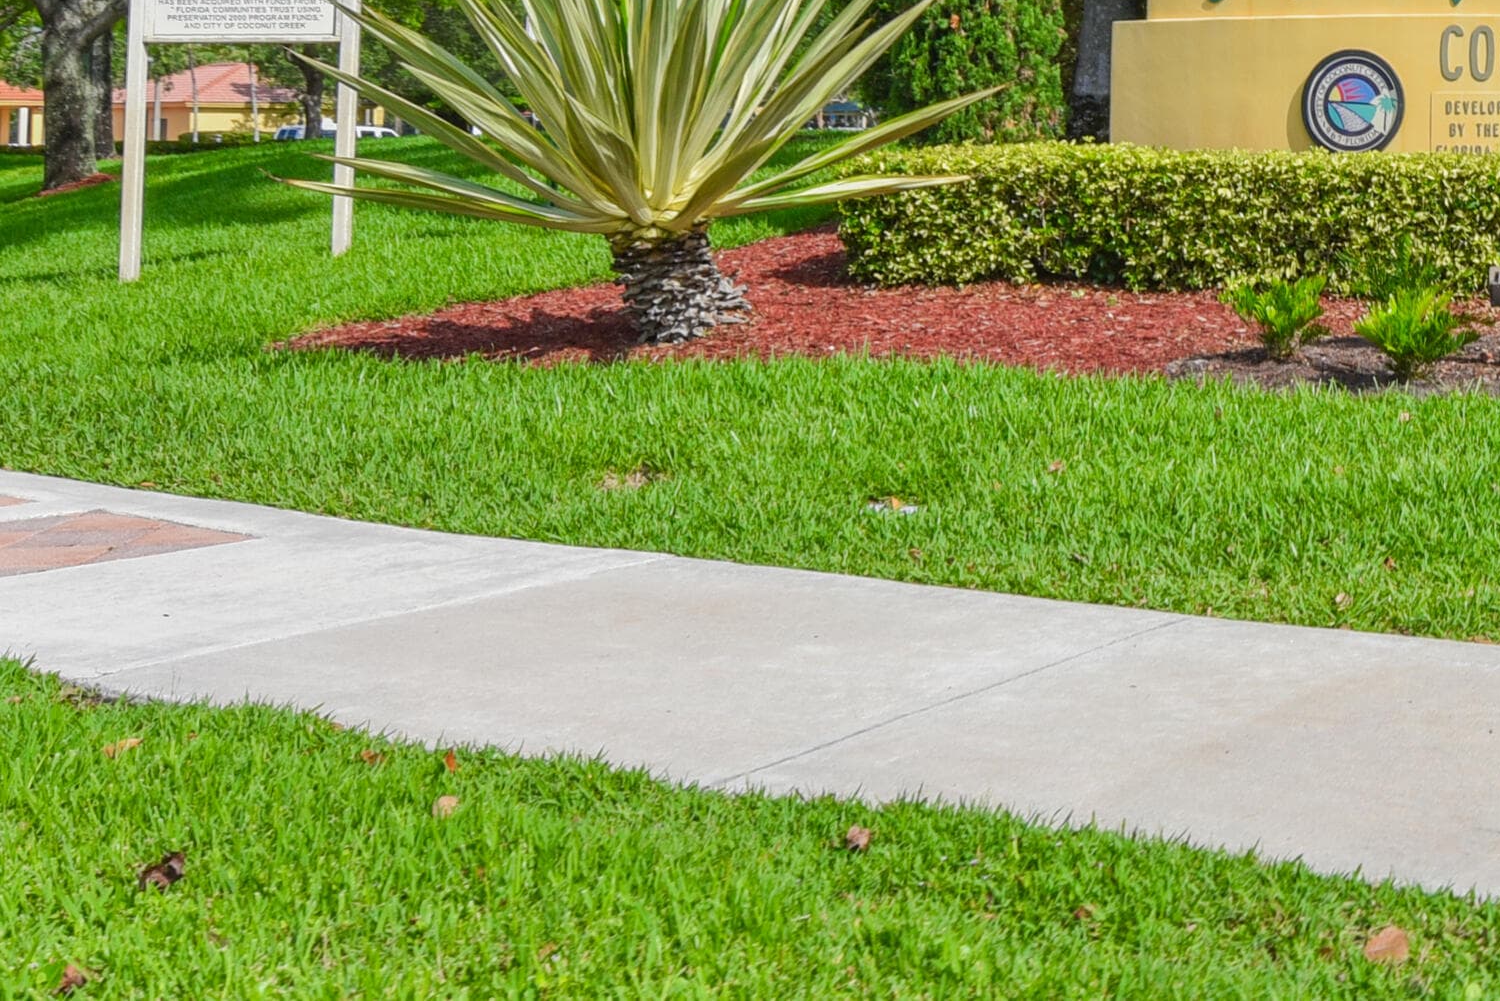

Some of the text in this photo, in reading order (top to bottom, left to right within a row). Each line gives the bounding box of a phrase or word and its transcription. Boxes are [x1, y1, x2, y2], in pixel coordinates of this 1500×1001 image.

[212, 6, 267, 14] COMMUNITIES
[269, 6, 295, 14] TRUST
[297, 6, 321, 14] USING
[167, 14, 227, 22] PRESERVATION
[228, 14, 247, 22] 2000
[248, 14, 290, 22] PROGRAM
[184, 22, 307, 30] AND CITY OF COCONUT CREEK
[1448, 122, 1466, 139] BY
[1475, 122, 1500, 139] THE
